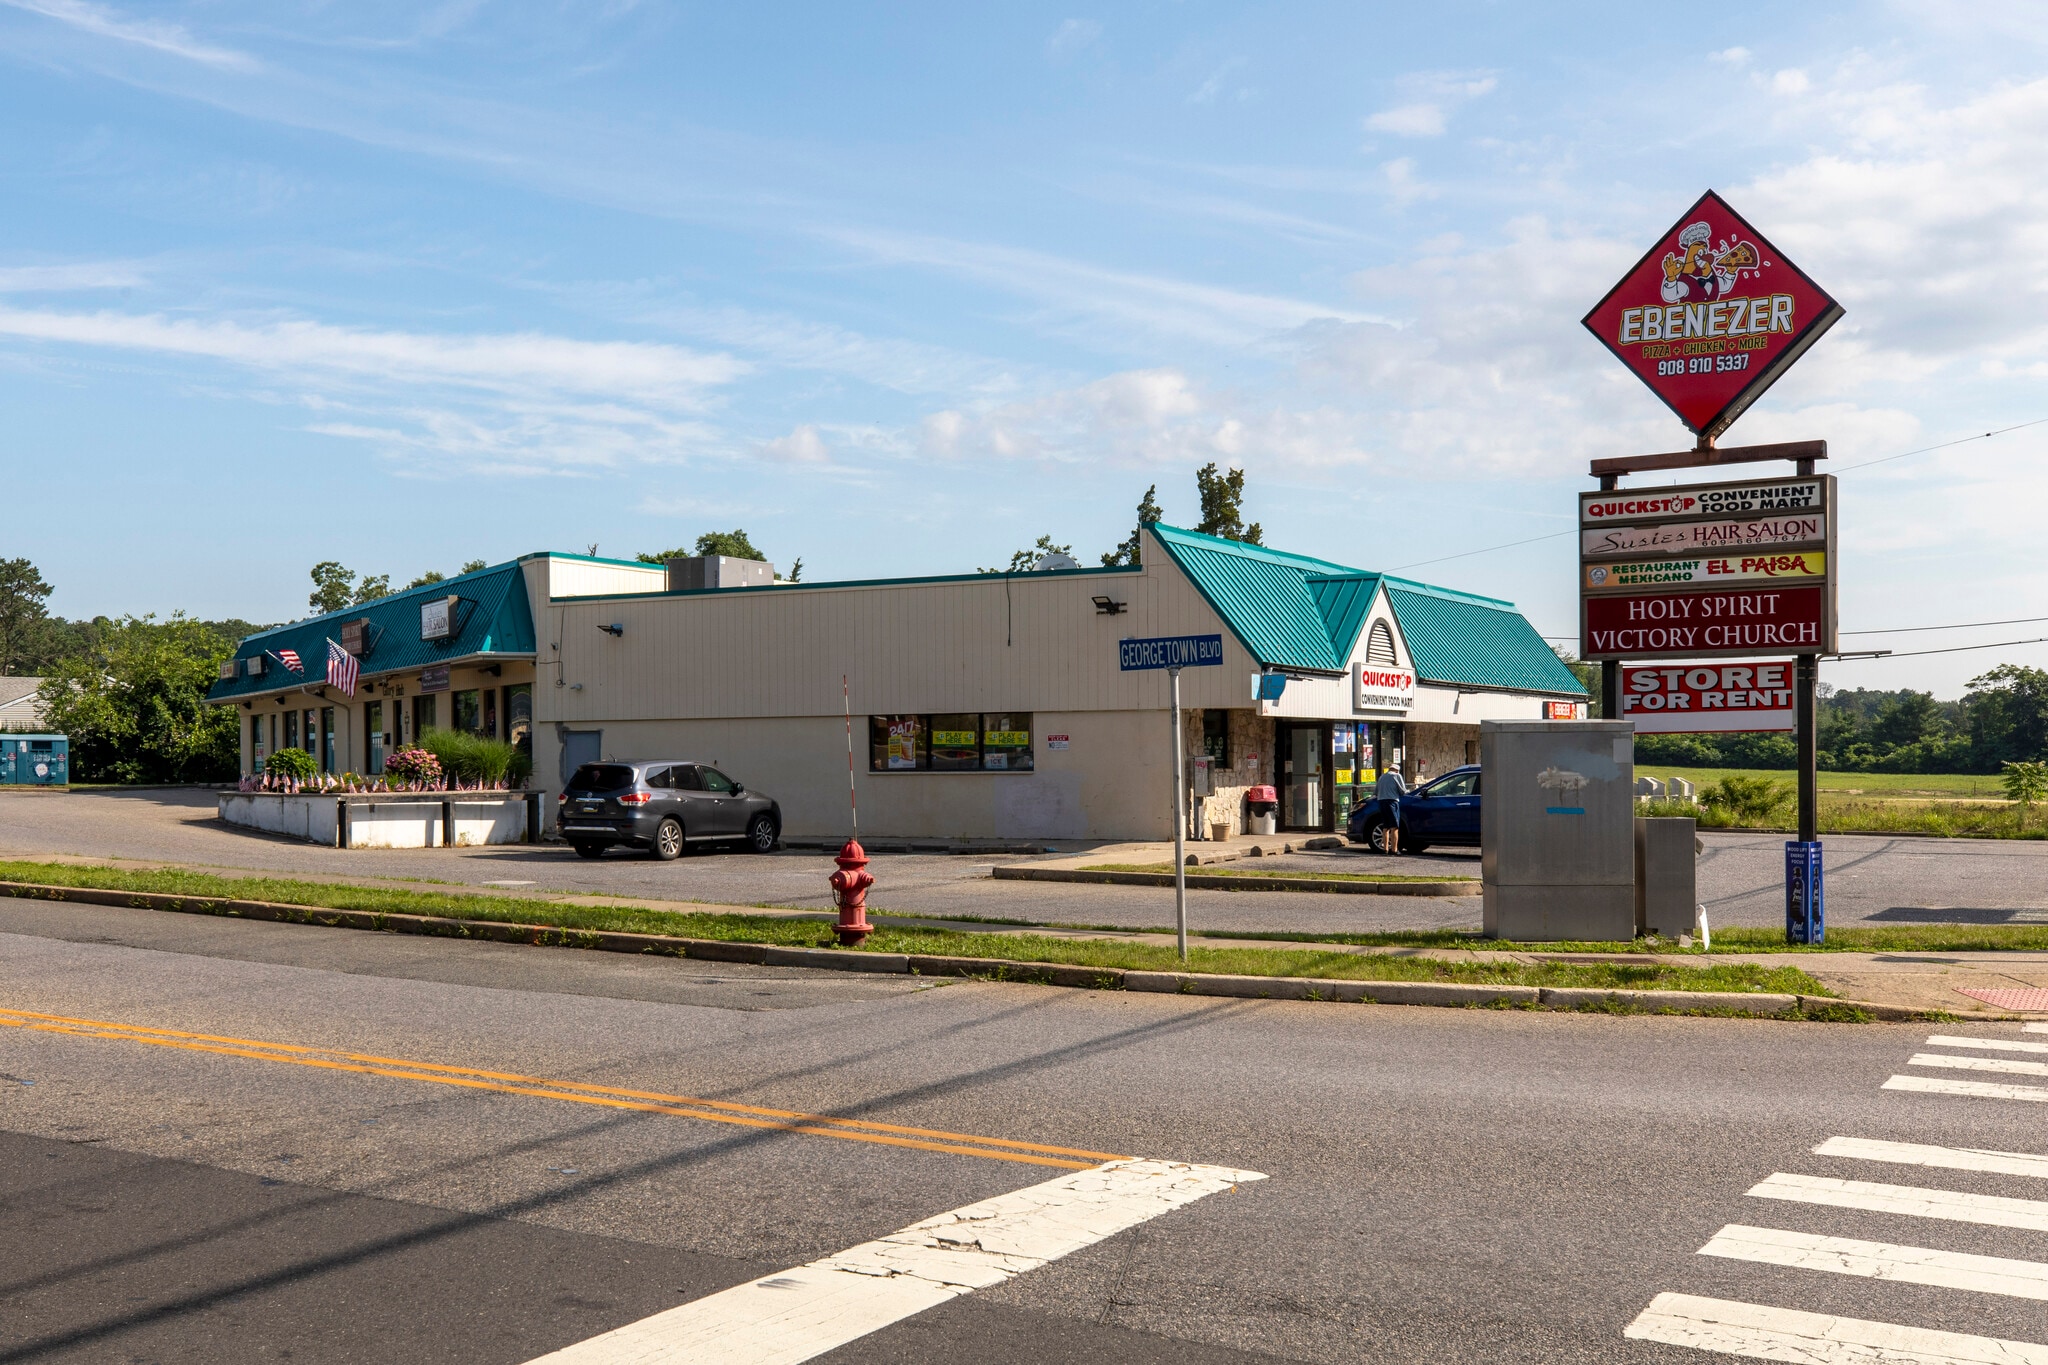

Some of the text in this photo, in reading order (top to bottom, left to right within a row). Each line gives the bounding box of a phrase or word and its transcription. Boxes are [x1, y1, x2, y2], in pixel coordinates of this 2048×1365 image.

[1619, 294, 1794, 345] EBENEZER
[1643, 345, 1671, 358] PIZZA
[1684, 340, 1725, 355] CHICKEN
[1739, 337, 1767, 350] MORE
[1658, 352, 1749, 376] 908 910 5337
[1698, 486, 1815, 503] CONVENIENT
[1702, 496, 1811, 513] FOOD MART
[1588, 495, 1695, 517] QUICKSTOP
[1694, 525, 1741, 541] HAIR
[1747, 520, 1816, 538] SALON
[1612, 561, 1700, 574] RESTAURANT
[1706, 555, 1818, 577] EL PAISA
[1619, 572, 1693, 584] MEXICANO
[1628, 594, 1780, 620] HOLY SPIRIT
[1592, 622, 1818, 650] VICTORY CHURCH
[1121, 640, 1221, 666] GEORGETOWN BLVD
[1362, 671, 1412, 691] QUICKSTOP
[1630, 666, 1785, 692] STORE
[1362, 694, 1412, 707] CONVENIENT FOOD MART
[1623, 690, 1792, 710] FOR RENT
